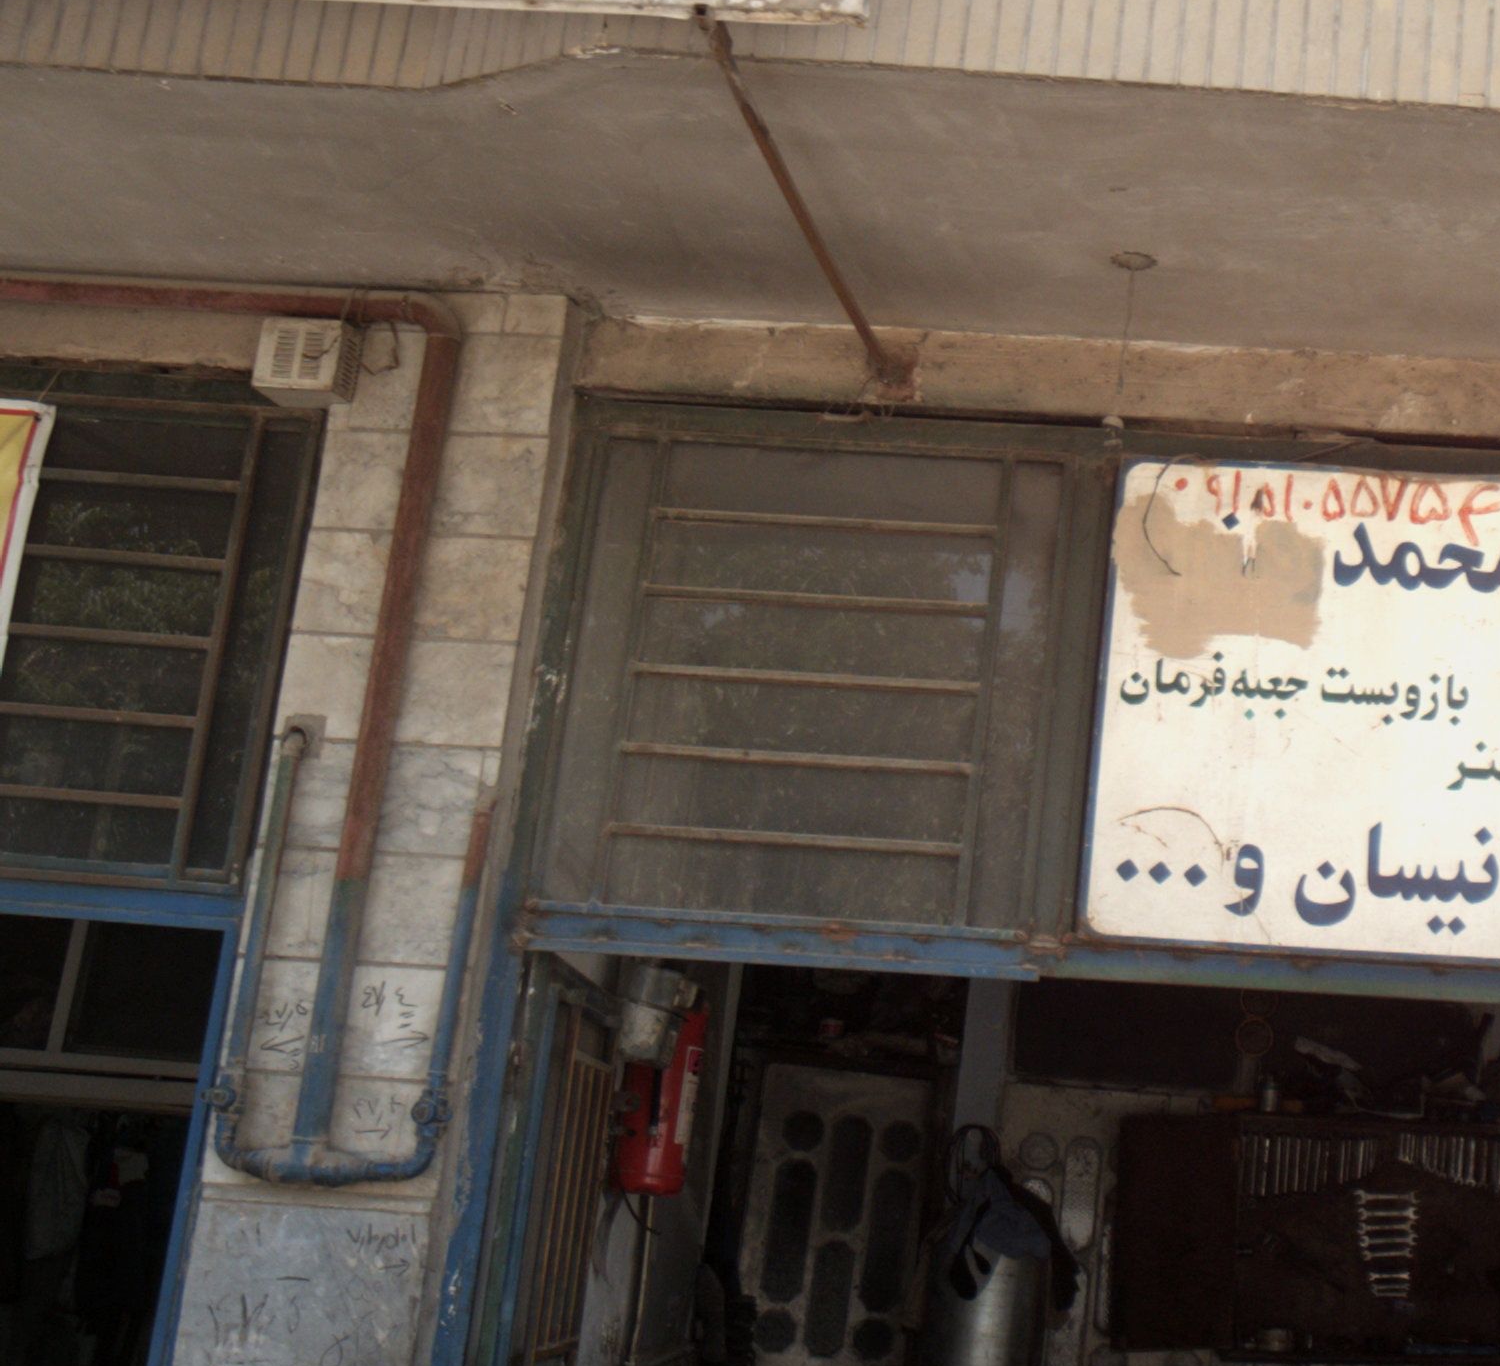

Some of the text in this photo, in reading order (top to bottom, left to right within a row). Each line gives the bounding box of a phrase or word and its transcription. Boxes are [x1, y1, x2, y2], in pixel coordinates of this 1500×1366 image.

[1120, 651, 1225, 707] فرمان
[1231, 668, 1308, 720] جعبه
[1294, 821, 1499, 936] نیسان
